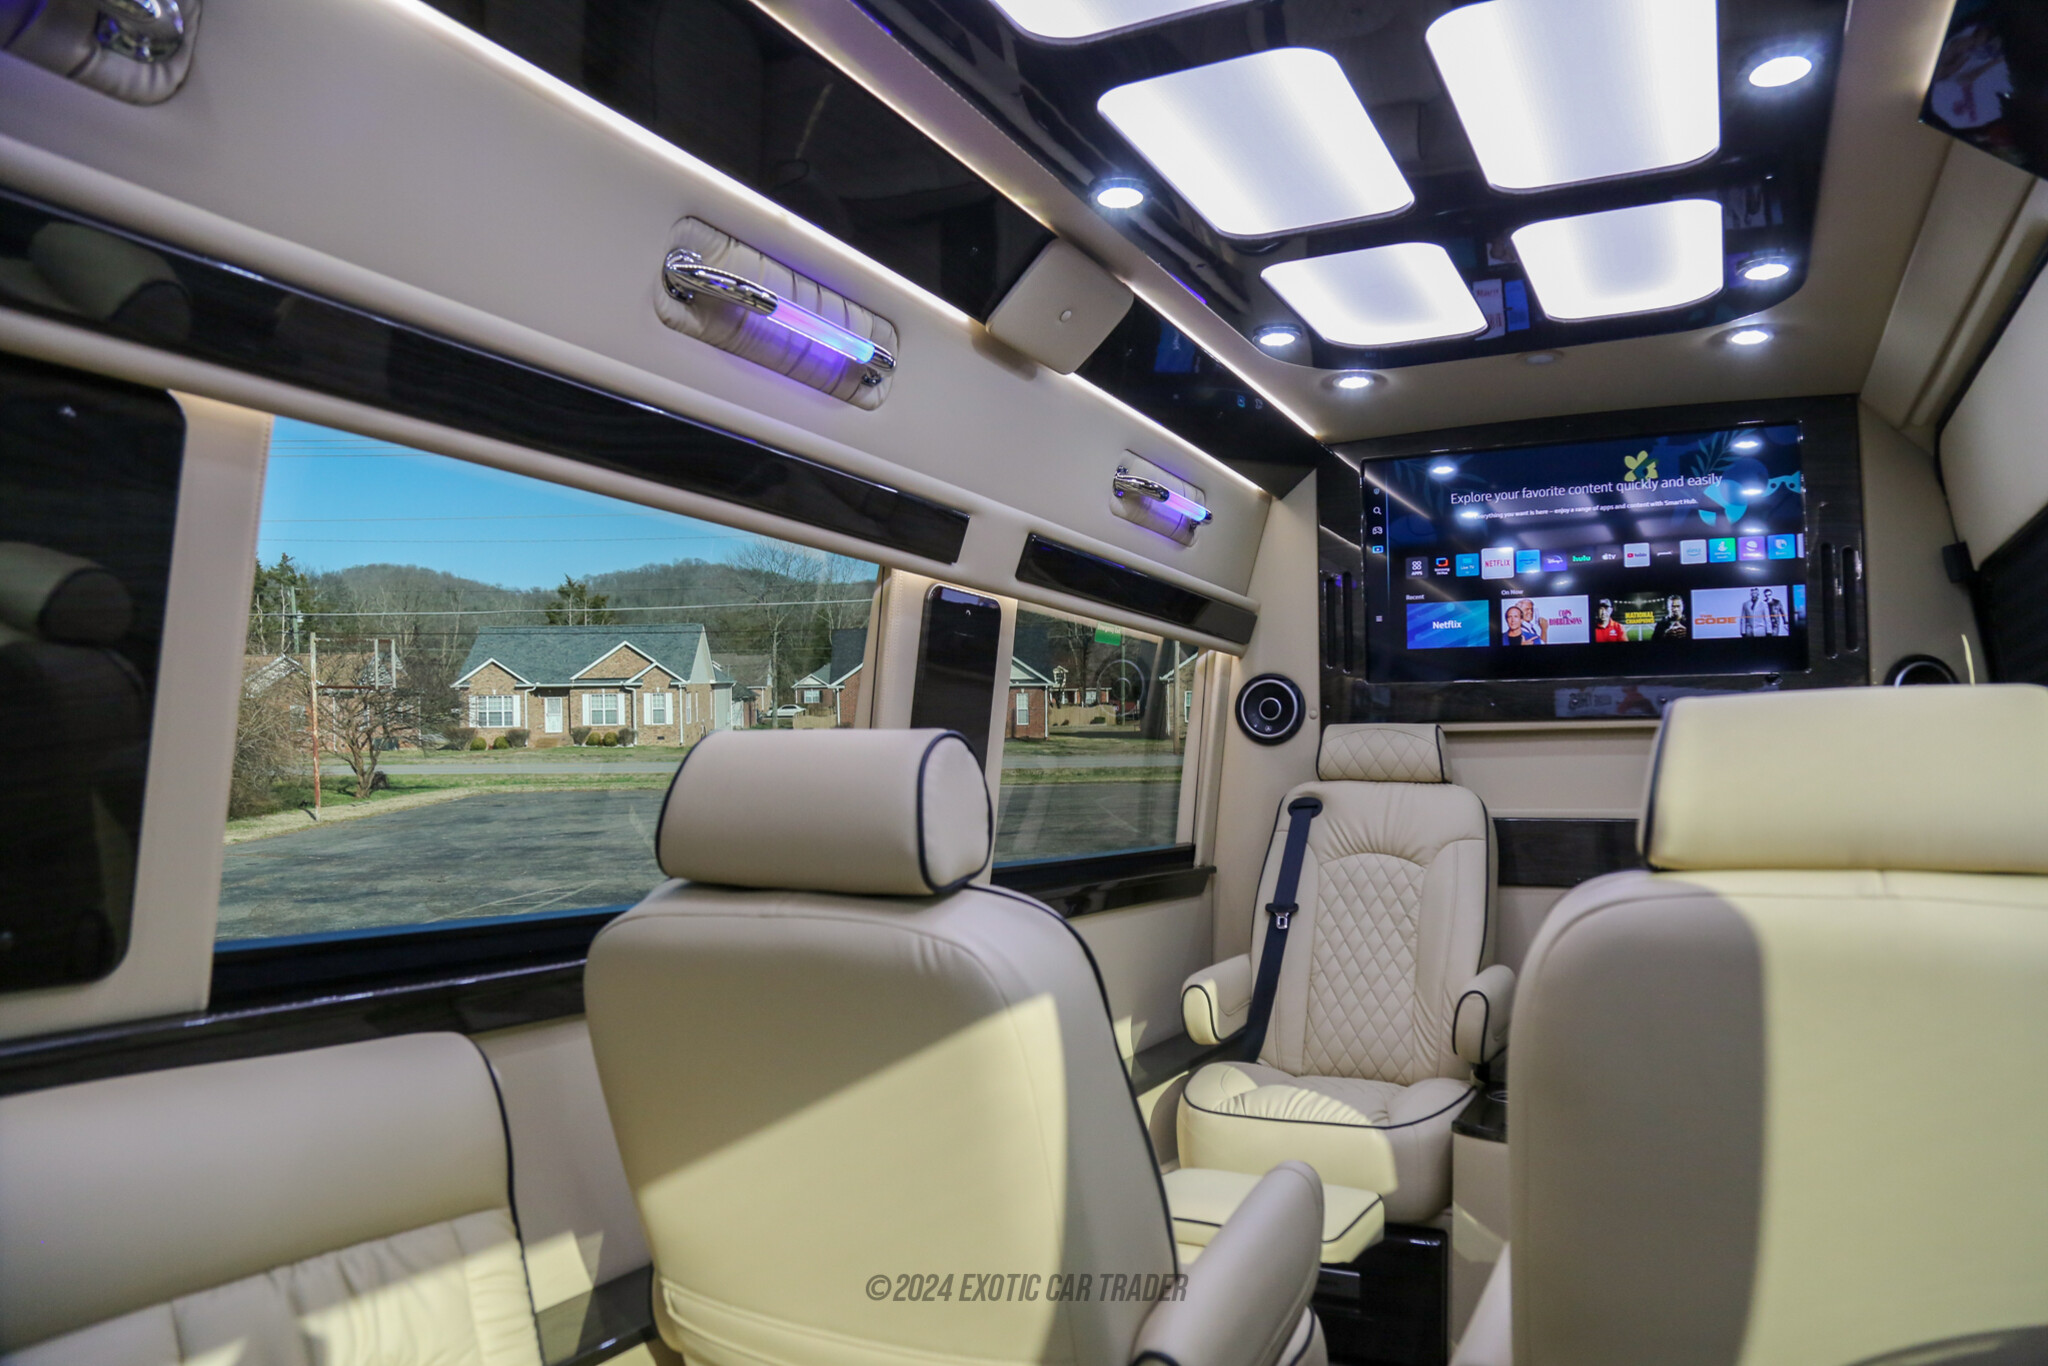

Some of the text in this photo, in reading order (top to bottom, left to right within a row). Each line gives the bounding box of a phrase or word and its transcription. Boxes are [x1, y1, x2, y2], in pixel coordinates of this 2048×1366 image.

[1450, 473, 1723, 505] Explore your favorite content quickly and easily
[1484, 559, 1511, 568] NETFLIX
[1432, 620, 1462, 630] Netflix
[1695, 617, 1737, 625] CODE
